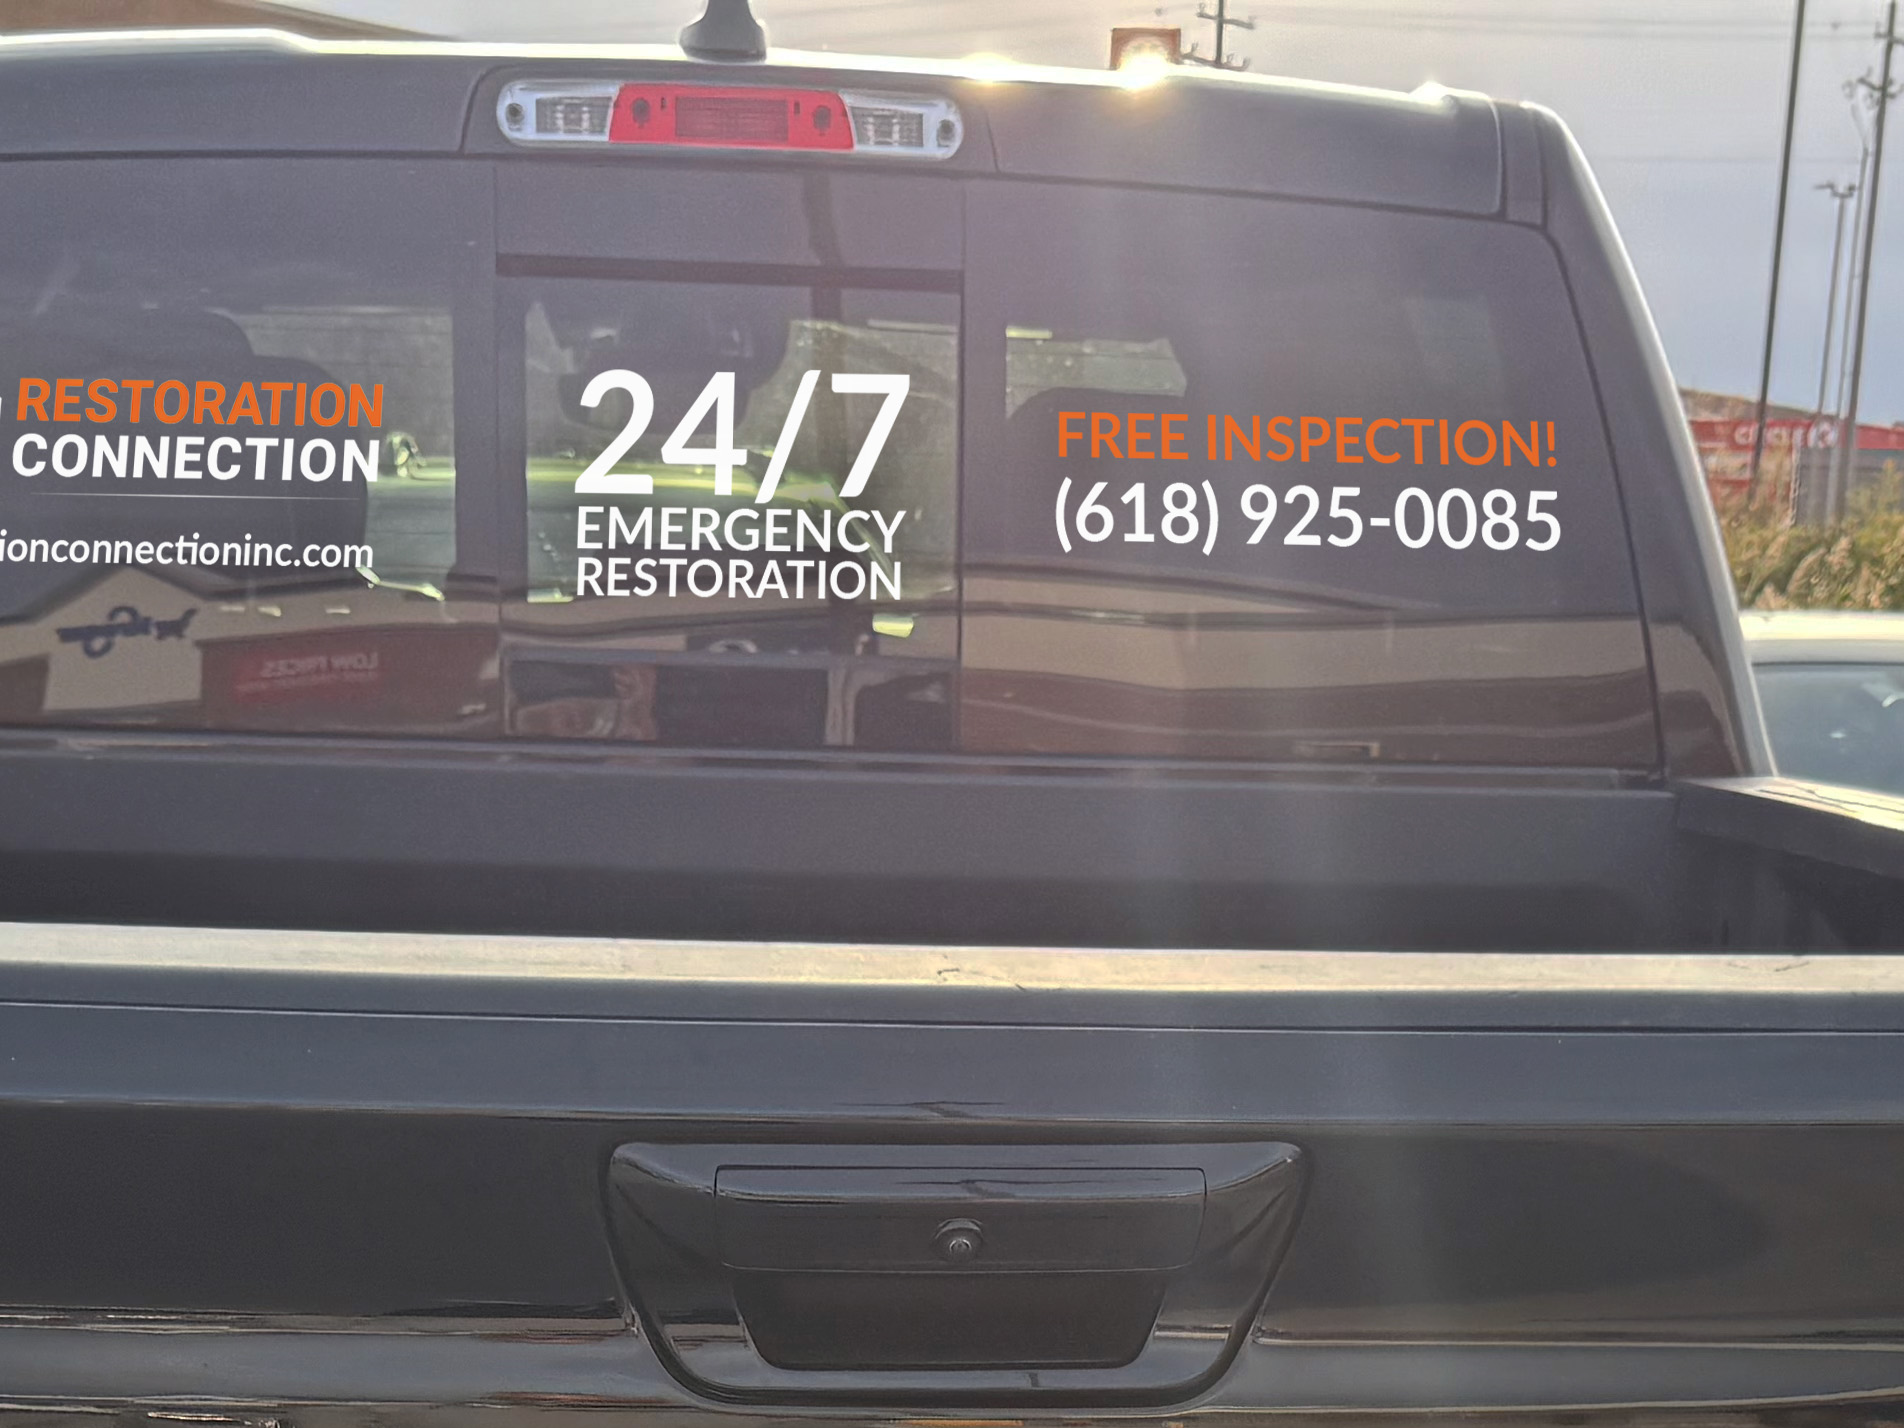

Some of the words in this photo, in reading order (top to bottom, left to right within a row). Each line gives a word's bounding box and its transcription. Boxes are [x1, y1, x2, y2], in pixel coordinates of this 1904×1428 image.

[16, 377, 384, 427] RESTORATION
[12, 433, 380, 483] CONNECTION
[574, 369, 910, 503] 24/7
[1057, 411, 1188, 460] FREE
[1207, 414, 1557, 467] INSPECTION!
[576, 506, 907, 554] EMERGENCY
[1055, 476, 1219, 556] (618)
[1240, 483, 1561, 551] 925-0085
[577, 557, 901, 601] RESTORATION
